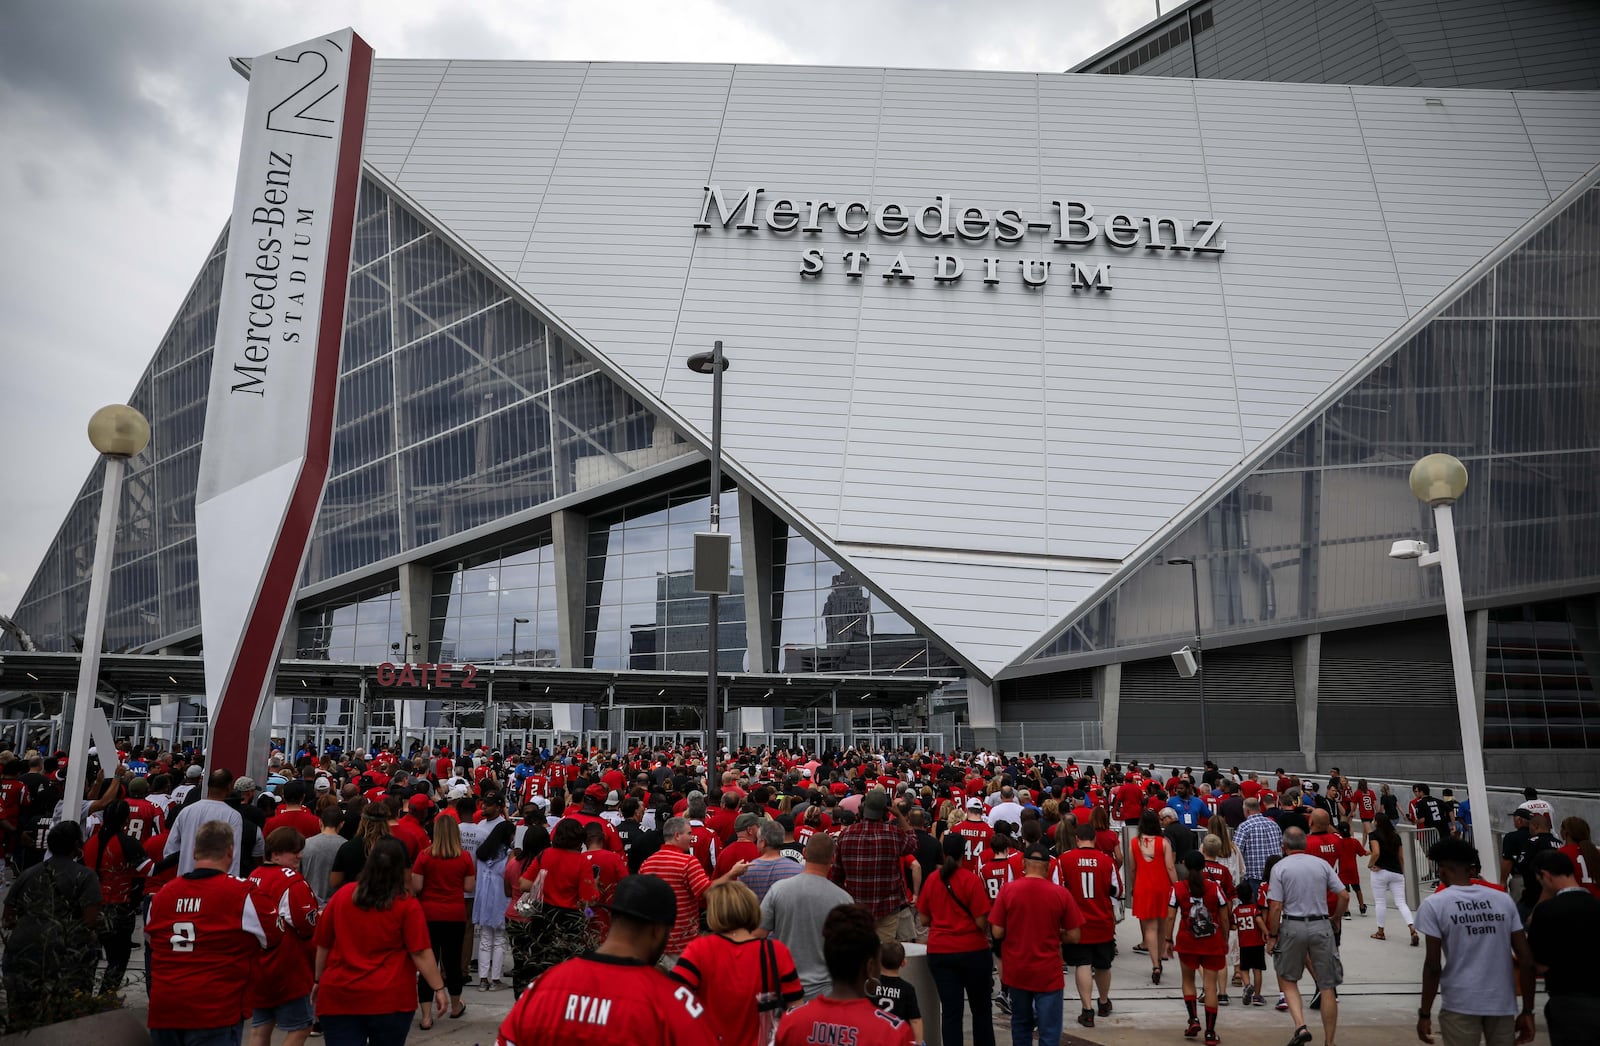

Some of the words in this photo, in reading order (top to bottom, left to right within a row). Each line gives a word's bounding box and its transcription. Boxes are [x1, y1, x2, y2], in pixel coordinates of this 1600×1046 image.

[693, 184, 1227, 254] Mercedes-Benz
[231, 150, 293, 398] Mercedes-Benz
[282, 207, 314, 344] STADIUM
[799, 247, 1113, 290] STADIUM
[377, 661, 453, 687] GATE
[461, 663, 478, 688] 2
[530, 784, 539, 795] 2
[1430, 806, 1442, 821] 2
[964, 839, 985, 861] 44
[1077, 858, 1098, 867] JONES
[1081, 872, 1095, 899] 11
[175, 898, 202, 912] RYAN
[1455, 900, 1493, 912] Ticket
[1237, 916, 1255, 931] 33
[1450, 911, 1505, 925] Volunteer
[1465, 924, 1496, 936] Team
[169, 921, 196, 952] 2
[674, 985, 705, 1019] 2
[875, 985, 900, 998] RYAN
[564, 994, 612, 1026] RYAN
[807, 1020, 860, 1046] JONES
